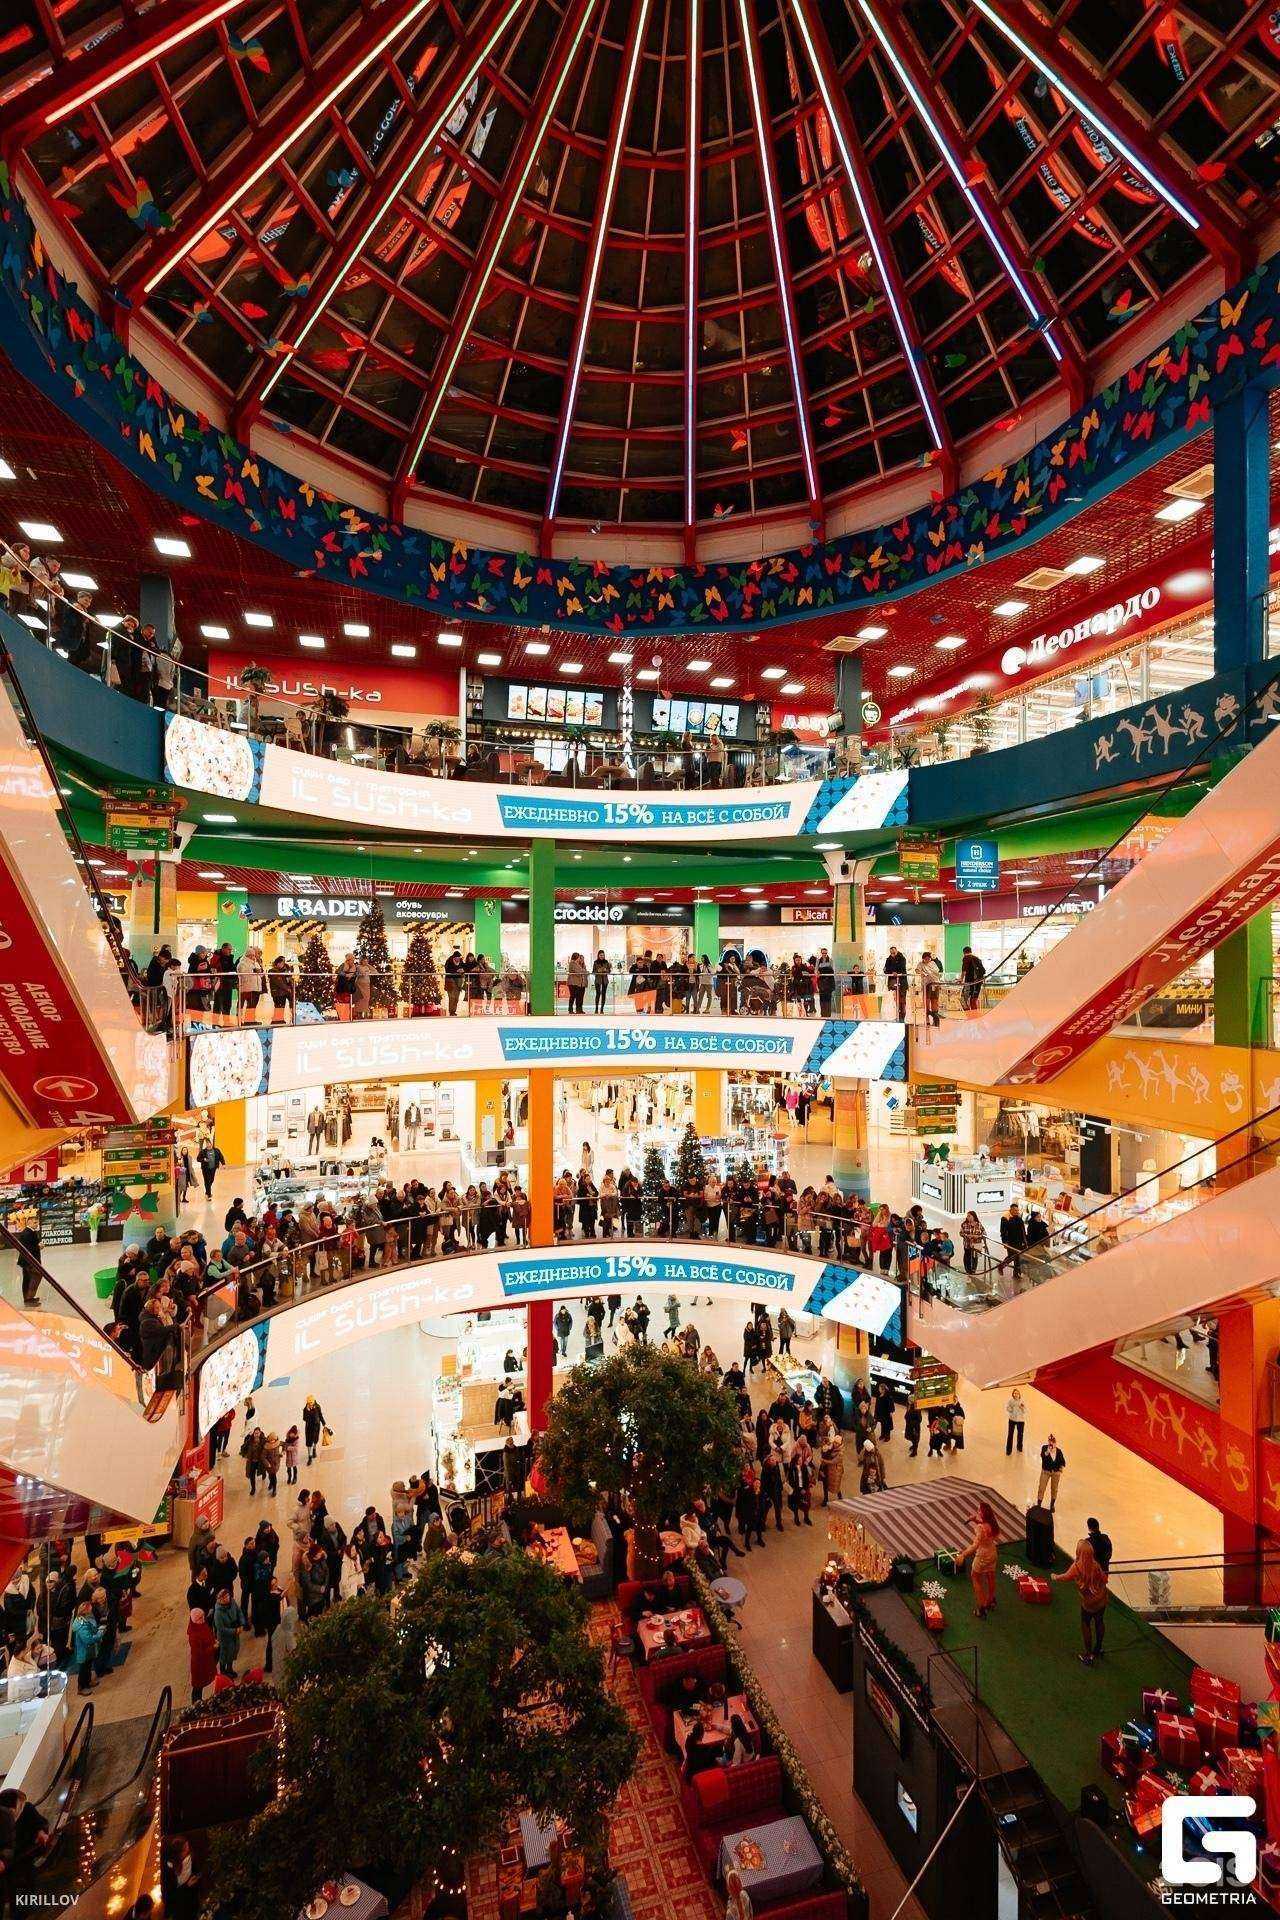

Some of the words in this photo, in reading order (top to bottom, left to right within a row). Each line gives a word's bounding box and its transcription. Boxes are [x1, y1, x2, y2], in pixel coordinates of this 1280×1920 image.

[1026, 586, 1161, 664] Леонардо
[504, 804, 599, 824] ЕЖЕДНЕВНО
[603, 803, 654, 824] 15%
[662, 811, 684, 824] НА
[687, 808, 715, 824] ВСЁ
[719, 810, 729, 823] С
[733, 803, 784, 822] СОБОЙ
[298, 899, 372, 916] BADEN
[554, 906, 608, 921] crockid
[795, 909, 828, 920] Plican
[1022, 904, 1047, 917] ЕСЛИ
[22, 982, 62, 1021] ДЕКОР
[0, 983, 50, 1049] РУКОДЕЛИЕ
[504, 1035, 601, 1052] ЕЖЕДНЕВНО
[605, 1028, 656, 1050] 15%
[664, 1036, 687, 1050] НА
[689, 1034, 719, 1051] ВСЁ
[721, 1039, 732, 1052] С
[735, 1036, 788, 1055] СОБОЙ
[504, 1265, 601, 1287] ЕЖЕДНЕВНО
[605, 1256, 657, 1279] 15%
[664, 1265, 687, 1278] НА
[689, 1262, 719, 1280] ВСЁ
[721, 1268, 732, 1282] С
[735, 1269, 789, 1291] СОБОЙ
